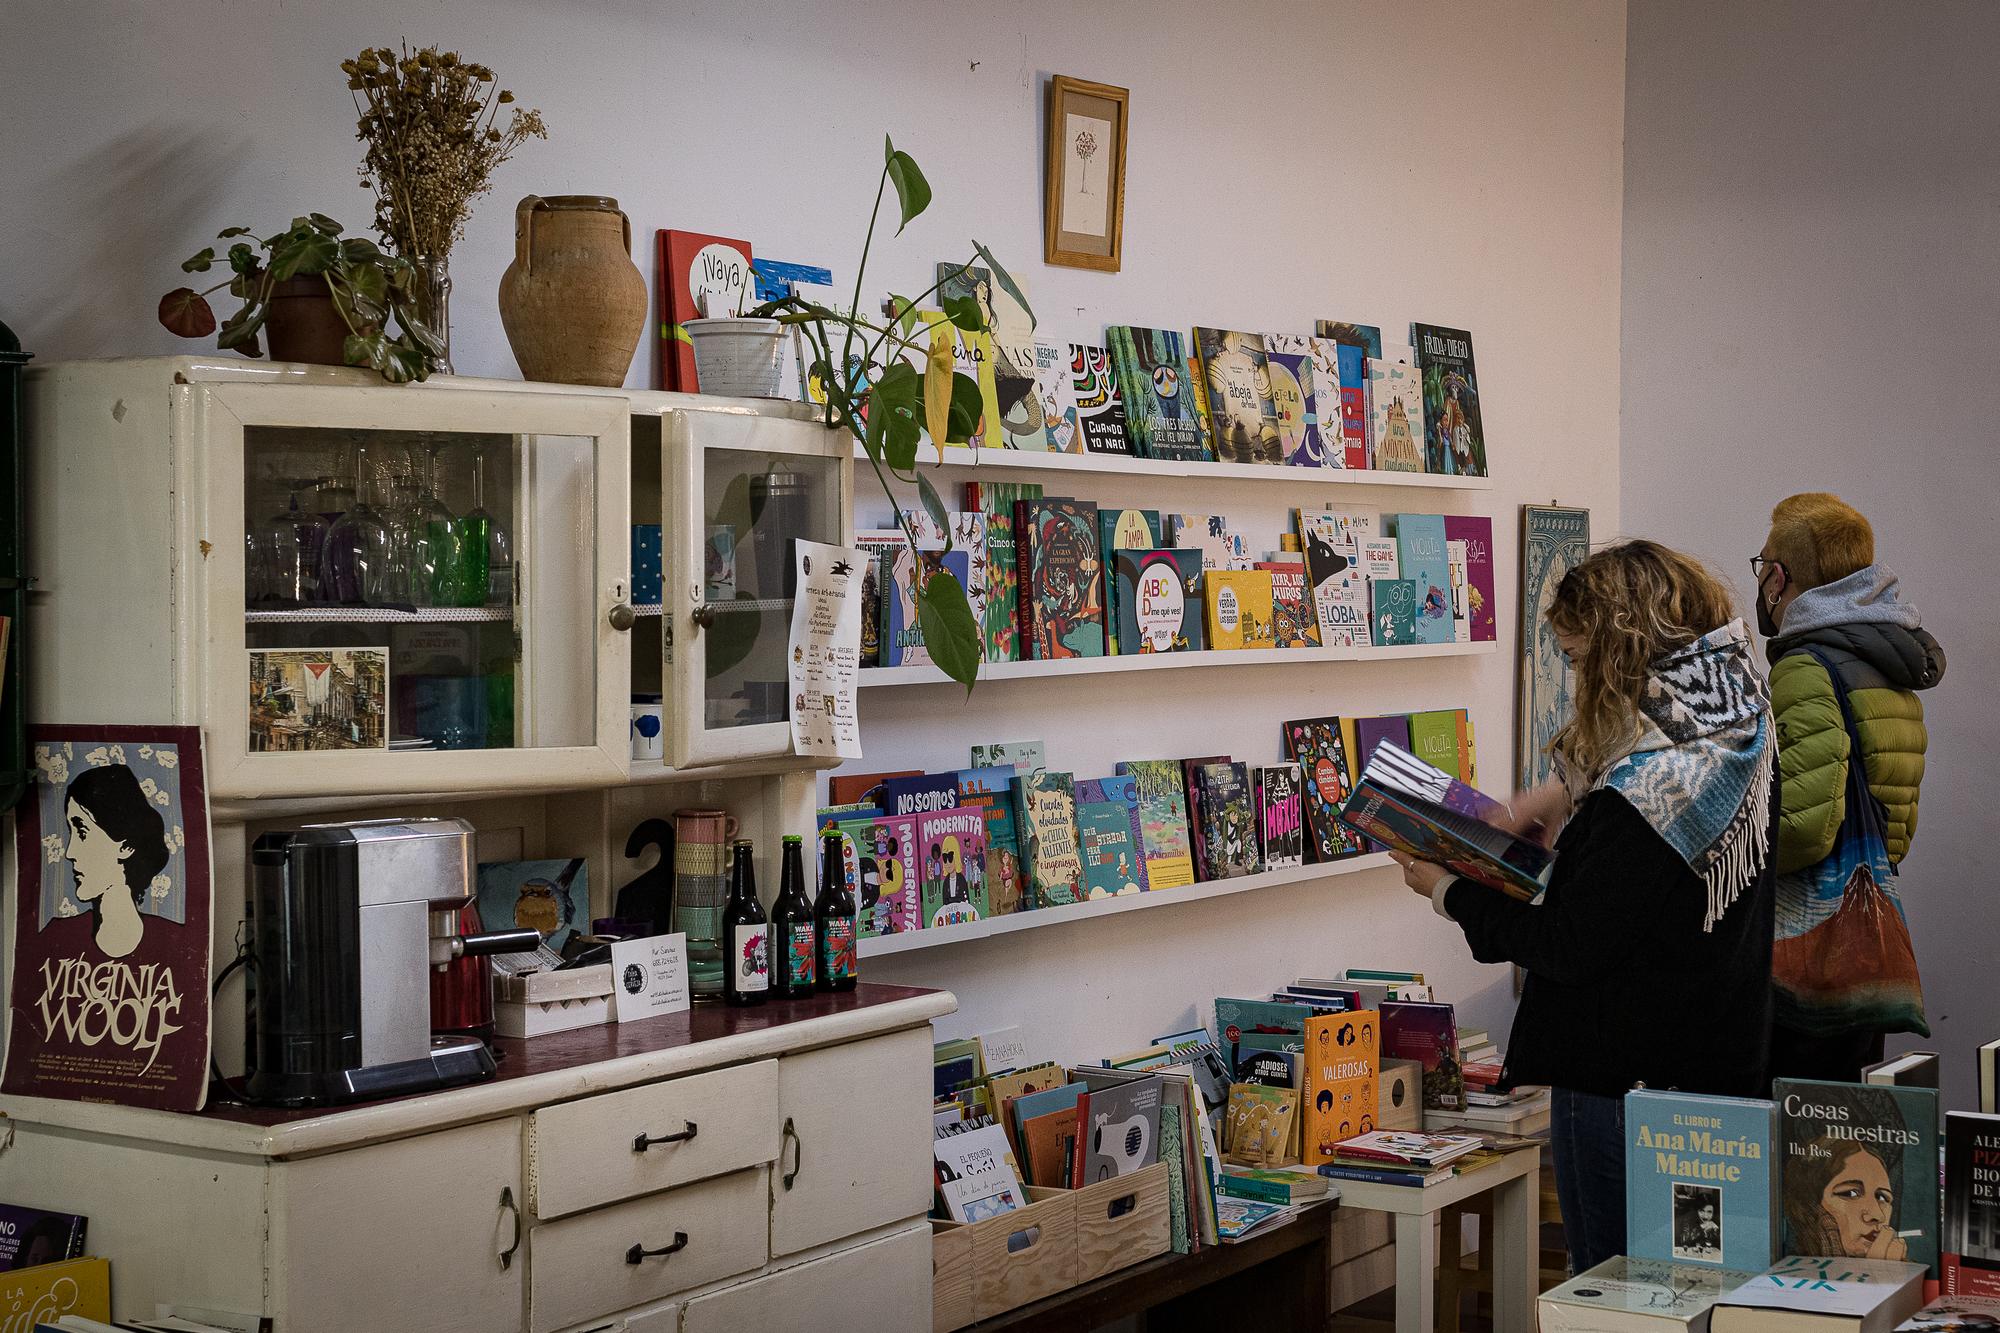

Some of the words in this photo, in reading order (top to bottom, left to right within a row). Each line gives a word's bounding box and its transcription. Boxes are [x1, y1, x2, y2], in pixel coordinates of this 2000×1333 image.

[1424, 335, 1445, 356] FRIDA
[1446, 338, 1468, 359] DIEGO
[1229, 380, 1253, 400] abeja
[1090, 438, 1102, 448] YO
[988, 537, 1010, 548] Cinco
[1201, 558, 1217, 569] edra
[1365, 550, 1377, 561] THE
[1377, 551, 1393, 561] GAME
[1143, 578, 1169, 598] ABC
[1272, 573, 1292, 588] AYAR
[1292, 574, 1305, 586] LOS
[1273, 587, 1303, 601] MUROS
[1021, 597, 1030, 621] GRAN
[1326, 605, 1357, 624] LOBA
[1317, 766, 1335, 776] Cambio
[898, 795, 914, 815] NO
[1040, 799, 1064, 813] Cuentos
[1039, 811, 1069, 829] olvidados
[1256, 784, 1264, 844] MOXIE
[1267, 793, 1300, 841] MOXIE
[1047, 827, 1069, 844] CHICAS
[1043, 841, 1072, 859] VALIENTES
[1045, 858, 1078, 877] ingeniosas
[794, 925, 814, 933] WAKA
[829, 919, 851, 928] WAKA
[38, 951, 183, 1002] VIRGINIA
[34, 990, 183, 1077] WOOLF
[1254, 1068, 1269, 1076] OTROS
[1260, 1060, 1288, 1073] ADIOSES
[1323, 1060, 1368, 1081] VALEROSAS
[1368, 1067, 1373, 1078] 2
[1784, 1094, 1849, 1121] Cosas
[1673, 1114, 1684, 1125] EL
[1686, 1115, 1708, 1127] LIBRO
[1710, 1117, 1722, 1129] DE
[1825, 1121, 1920, 1146] nuestras
[1973, 1134, 2000, 1148] ALE
[1636, 1125, 1684, 1152] Ana
[1688, 1129, 1761, 1160] María
[1789, 1142, 1806, 1158] Ilu
[1809, 1143, 1833, 1160] Ros
[960, 1154, 968, 1164] EL
[968, 1147, 993, 1163] PEQUEÑO
[1974, 1150, 2000, 1165] PIZ
[1655, 1152, 1741, 1183] Matute
[1973, 1167, 2000, 1182] BIO
[1973, 1183, 1993, 1197] DE
